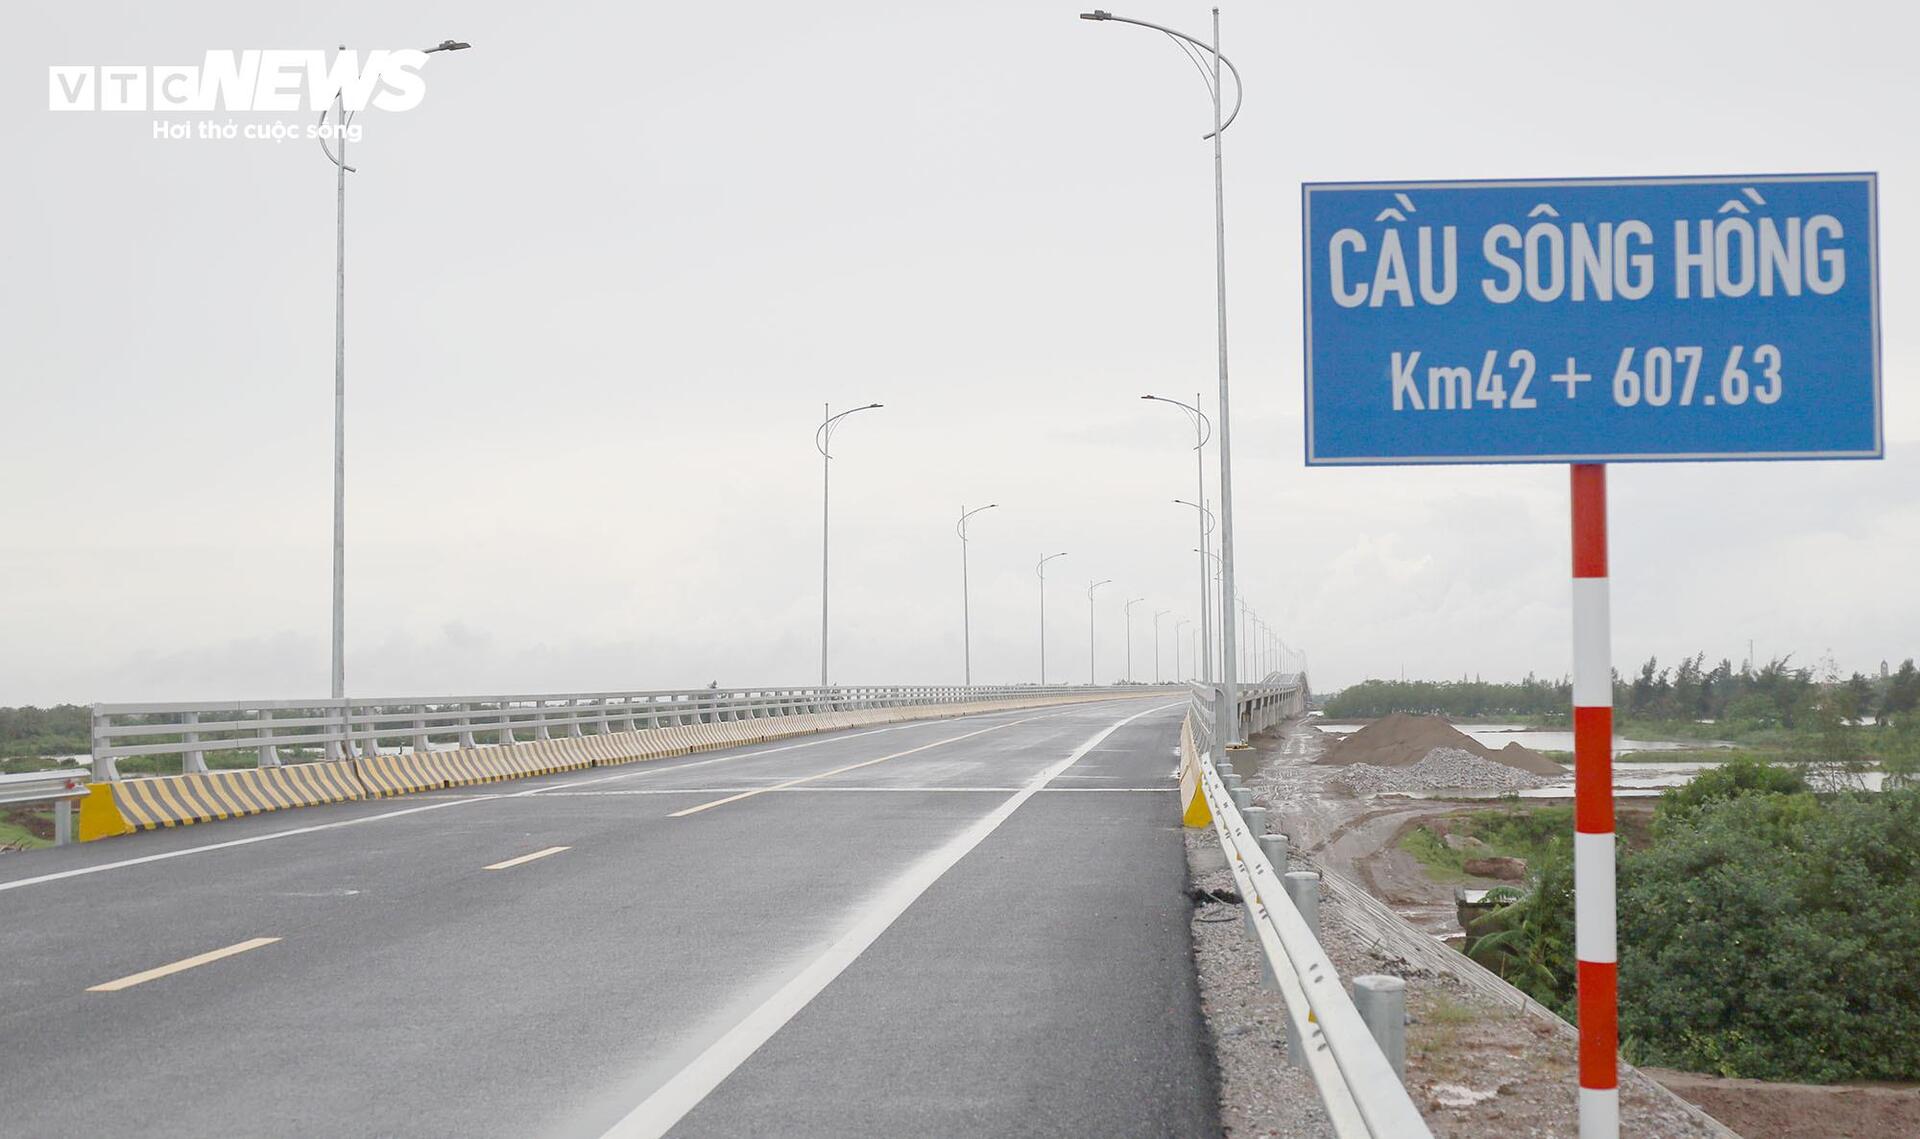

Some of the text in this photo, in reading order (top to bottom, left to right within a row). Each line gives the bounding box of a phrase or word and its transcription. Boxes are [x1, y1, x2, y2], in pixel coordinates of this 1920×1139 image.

[1329, 188, 1846, 308] CẦU SÔNG HỒNG
[1390, 349, 1538, 411] Km42
[1612, 344, 1783, 408] 607.63
